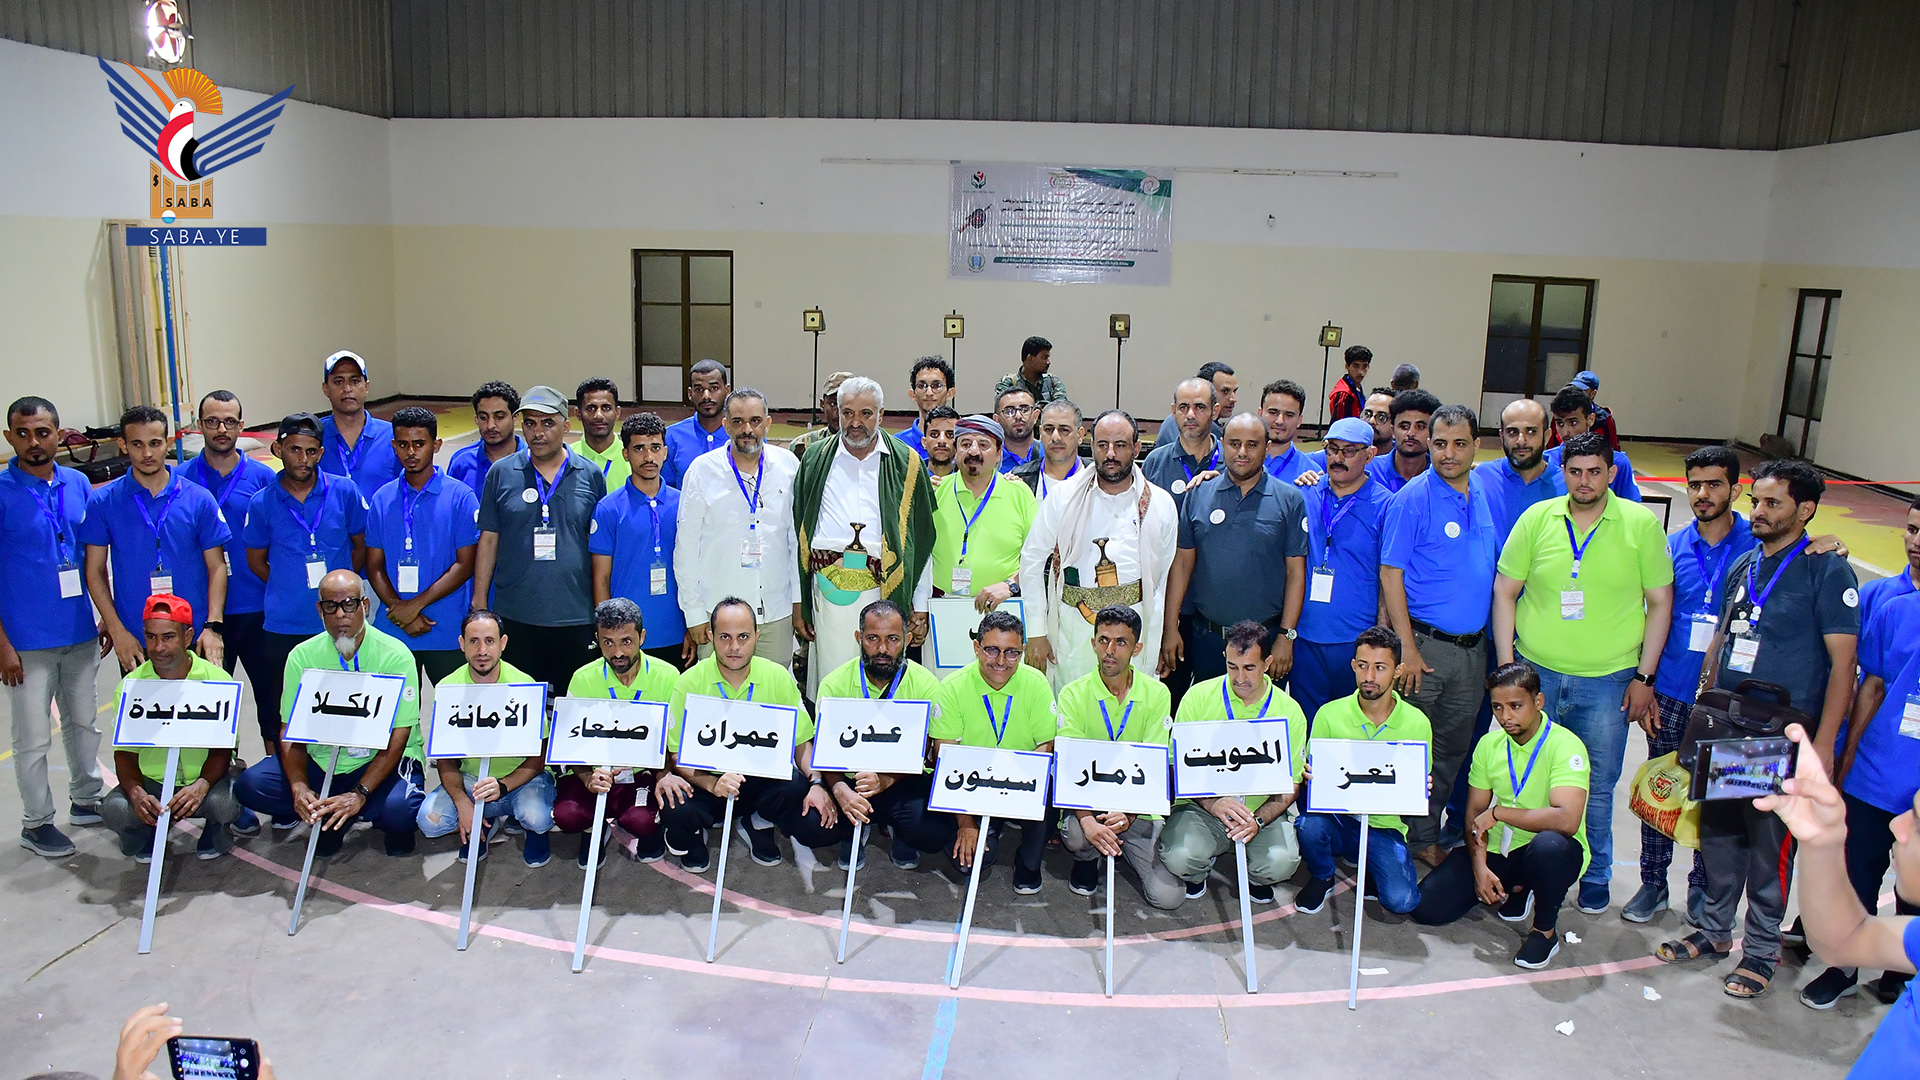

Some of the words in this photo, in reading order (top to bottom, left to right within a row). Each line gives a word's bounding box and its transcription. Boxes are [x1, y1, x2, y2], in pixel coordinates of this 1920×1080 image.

[127, 697, 231, 727] الحديدة
[310, 691, 384, 720] المكلا
[447, 699, 529, 730] الأمانة
[569, 716, 650, 742] صنعاء
[696, 718, 780, 751] عمران
[838, 723, 903, 749] عدن
[1182, 738, 1283, 774] المحويت
[943, 766, 1038, 795] سيئون
[1074, 759, 1146, 788] ذمار
[1336, 763, 1397, 791] تعز
